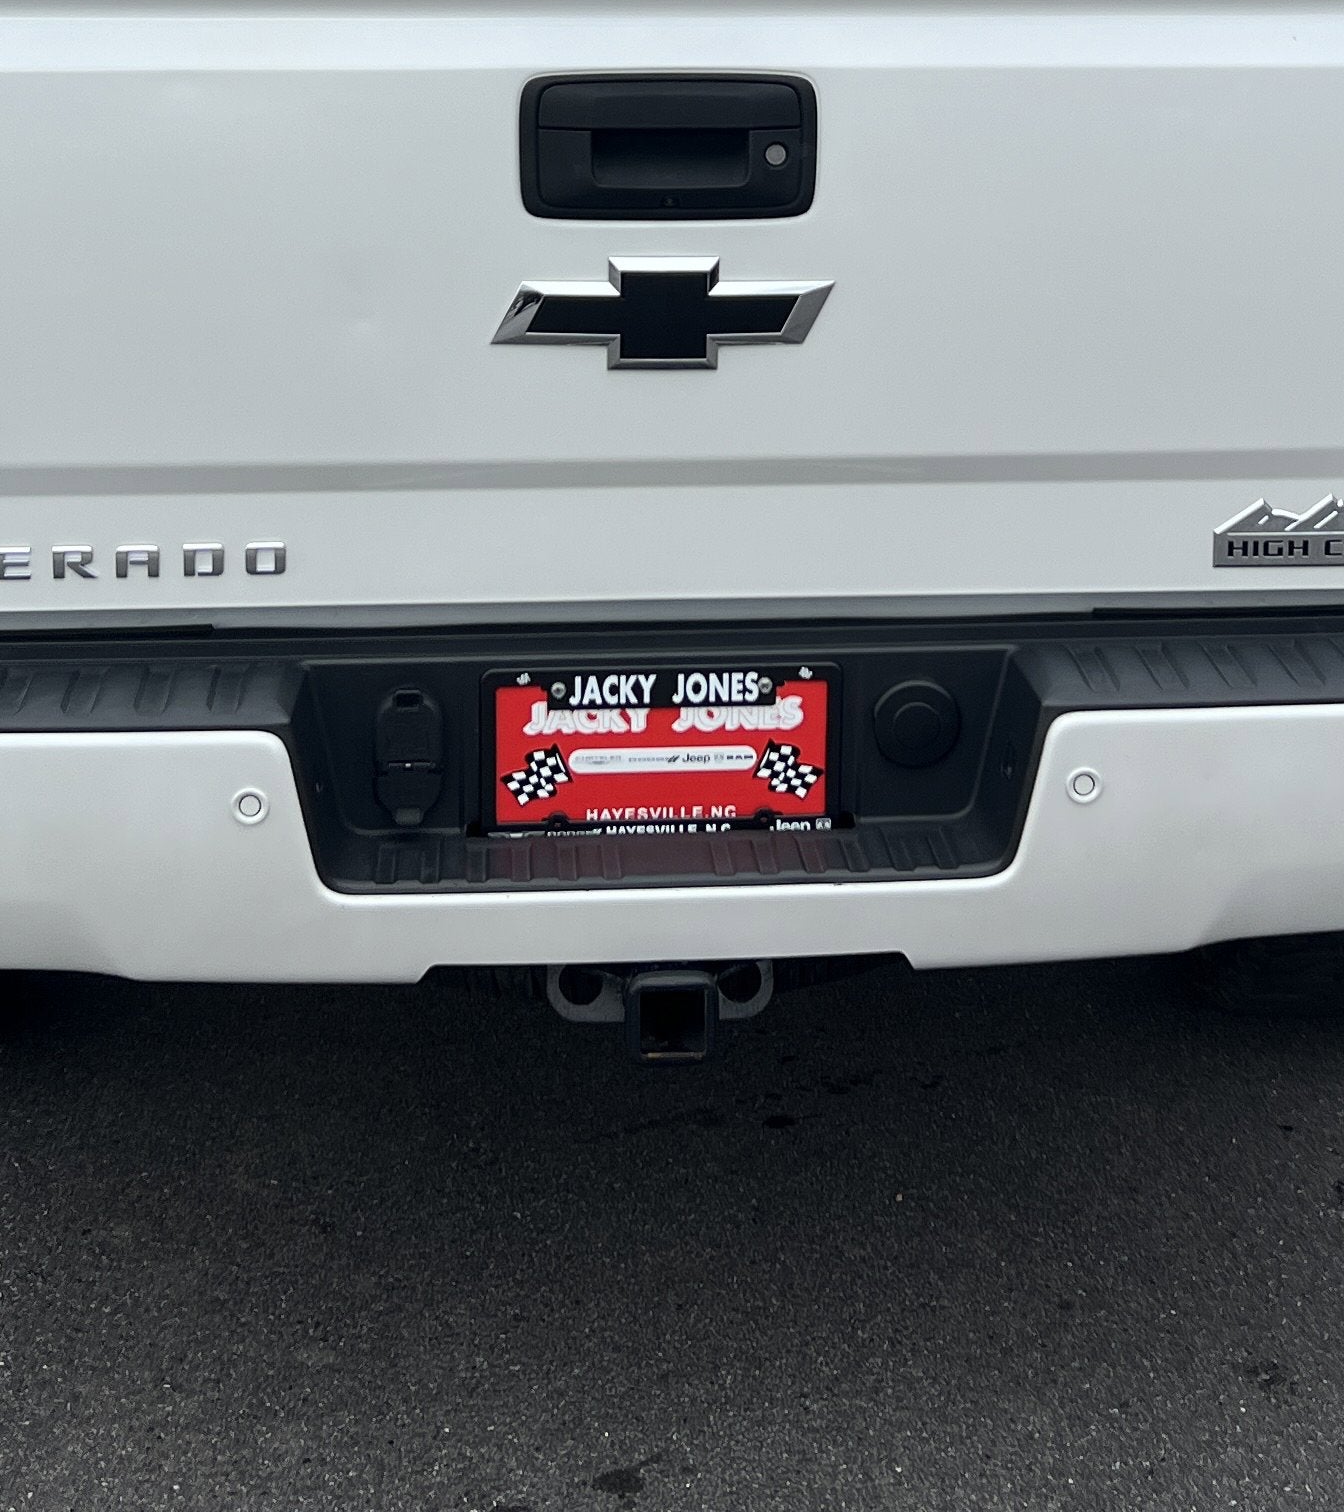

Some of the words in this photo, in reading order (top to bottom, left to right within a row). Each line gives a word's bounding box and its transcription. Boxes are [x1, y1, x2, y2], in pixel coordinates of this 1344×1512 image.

[1227, 540, 1309, 557] HIGH
[569, 674, 657, 706] JACKY
[672, 672, 760, 704] JONES
[682, 753, 710, 764] Jeep
